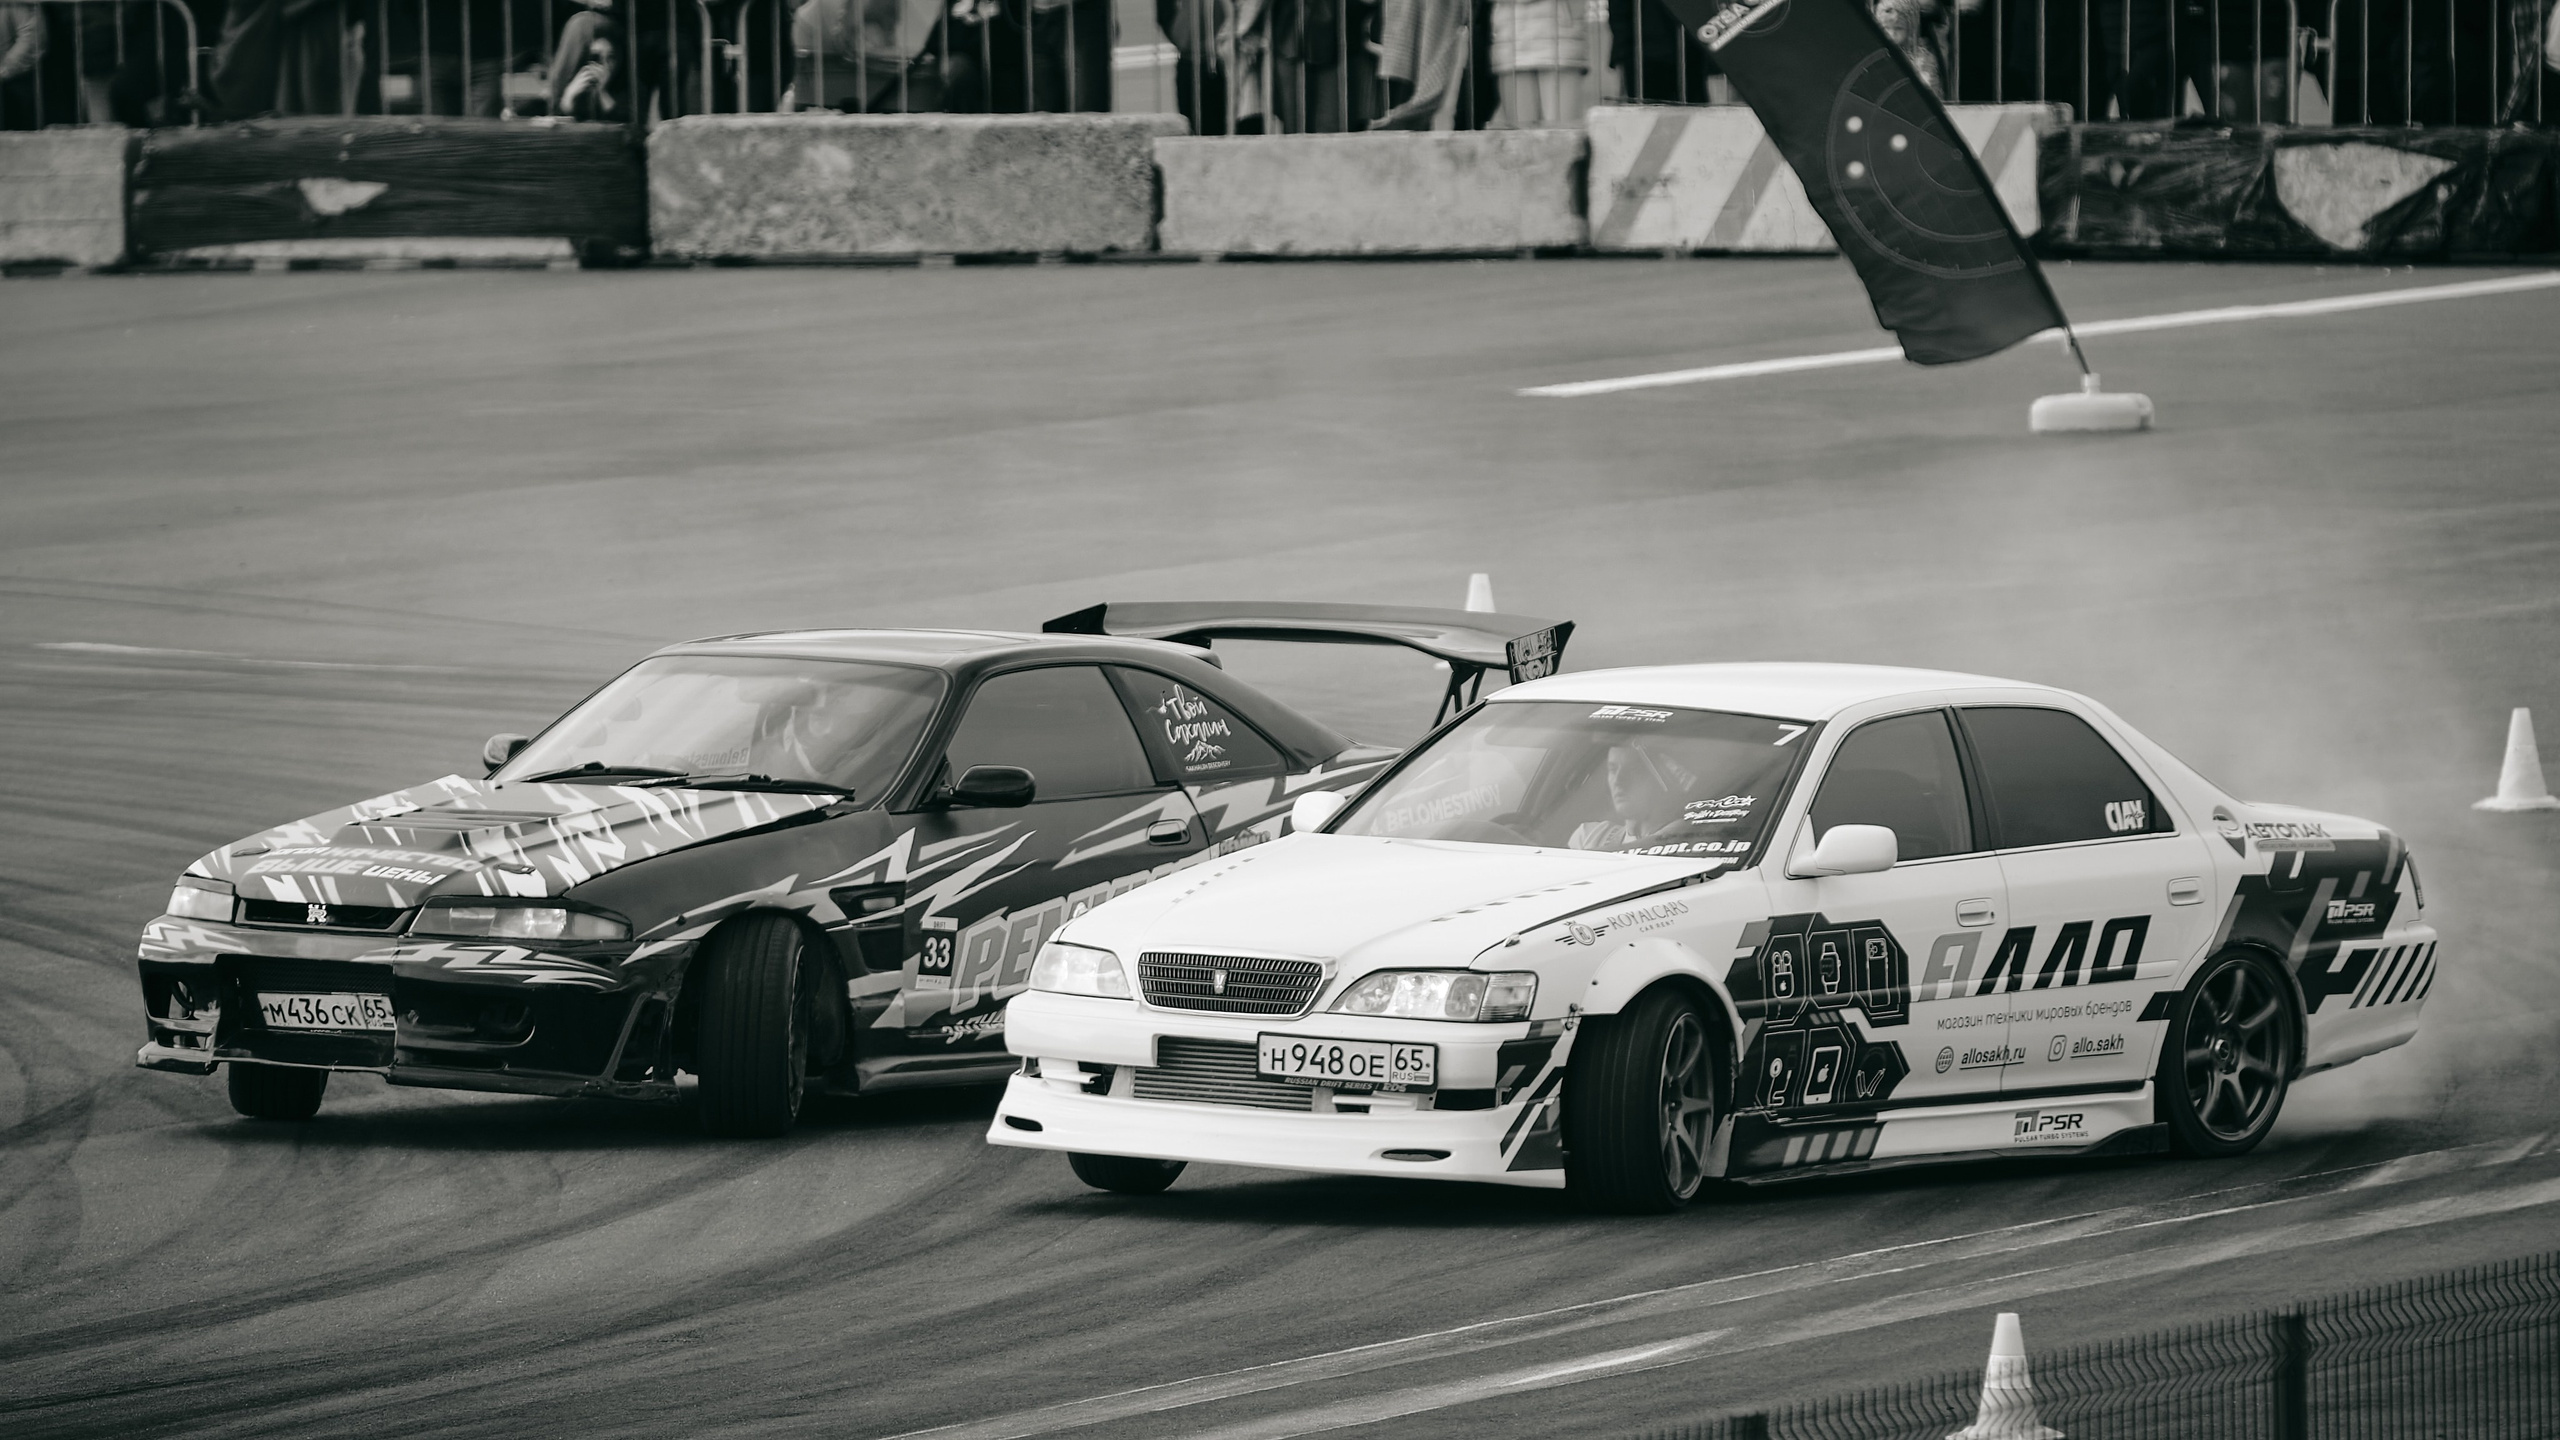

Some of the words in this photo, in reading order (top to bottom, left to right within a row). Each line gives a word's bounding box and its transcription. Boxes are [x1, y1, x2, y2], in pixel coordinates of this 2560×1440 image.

[1619, 707, 1674, 719] PSR
[1165, 718, 1231, 745] Сахалин
[1773, 724, 1808, 746] 7
[2245, 822, 2331, 839] АВТОПАК
[250, 858, 375, 875] ВЫШЕ
[362, 864, 447, 886] ЦЕНЫ
[2343, 903, 2376, 917] PSR
[924, 936, 950, 969] 33
[1918, 914, 2152, 1003] АЛЛО
[364, 998, 387, 1019] 65
[1937, 1014, 1983, 1030] магазин
[1985, 1009, 2033, 1024] техники
[2036, 1004, 2083, 1022] мировых
[2086, 999, 2132, 1020] брендов
[2072, 1033, 2124, 1054] allo.sakh
[1394, 1048, 1423, 1072] 65
[1961, 1045, 2026, 1065] allosakh.ru
[1284, 1077, 1318, 1087] RUSSIAN
[1320, 1080, 1343, 1089] DRIFT
[1344, 1081, 1373, 1090] SERIES
[1392, 1072, 1413, 1081] RUS
[2039, 1113, 2083, 1131] PSR
